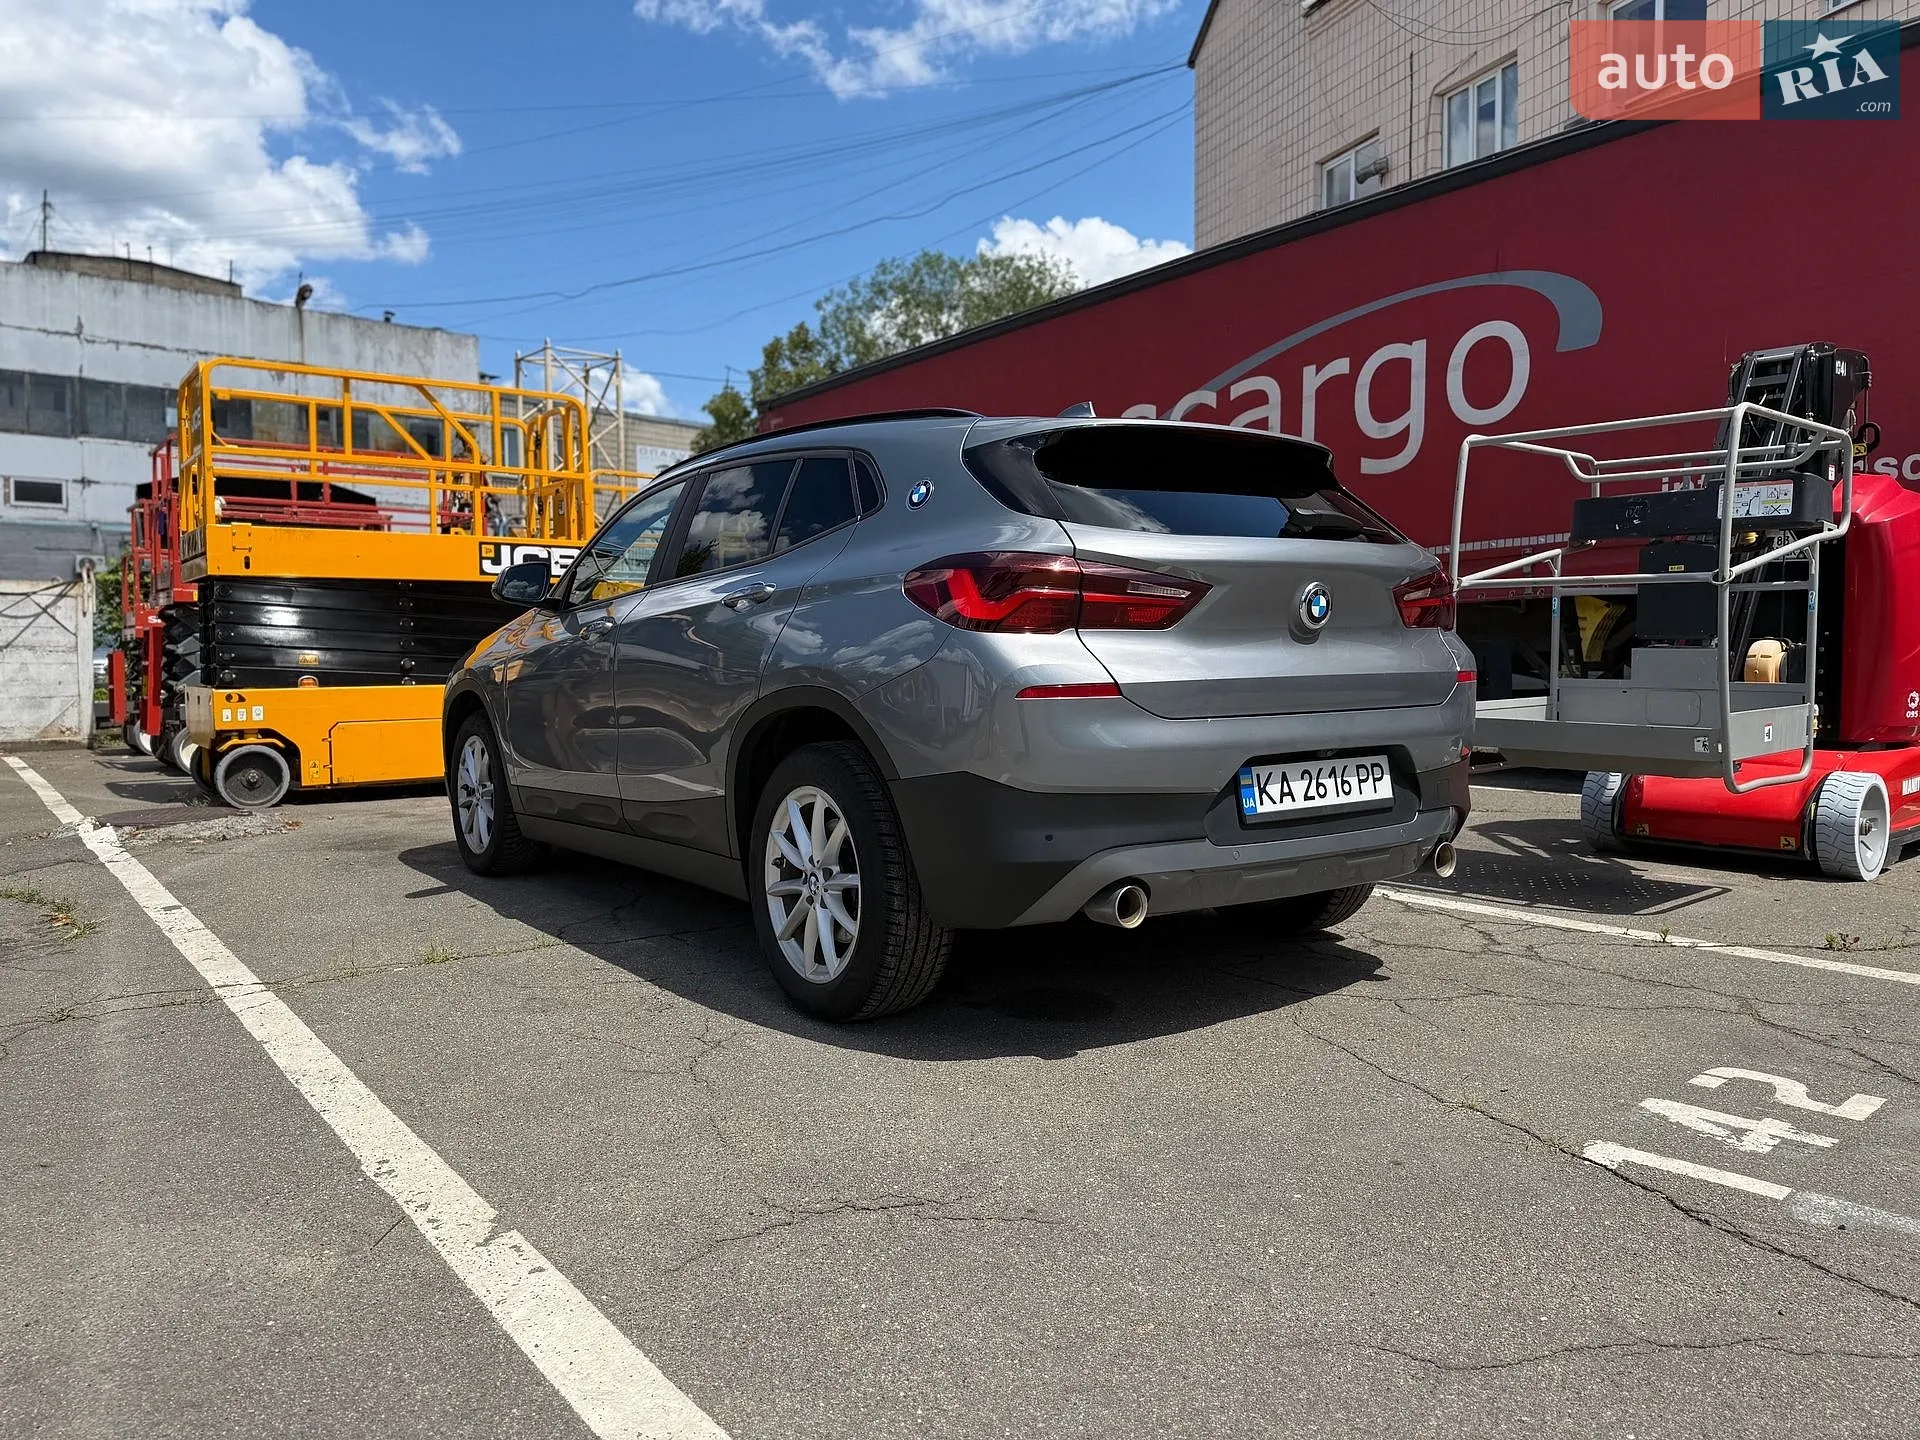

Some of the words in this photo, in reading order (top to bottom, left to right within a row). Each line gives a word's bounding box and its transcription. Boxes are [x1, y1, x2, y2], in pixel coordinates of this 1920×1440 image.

[1256, 771, 1296, 806] KA
[1301, 764, 1351, 801] 2616
[1355, 762, 1385, 795] PP
[1243, 797, 1255, 808] UA
